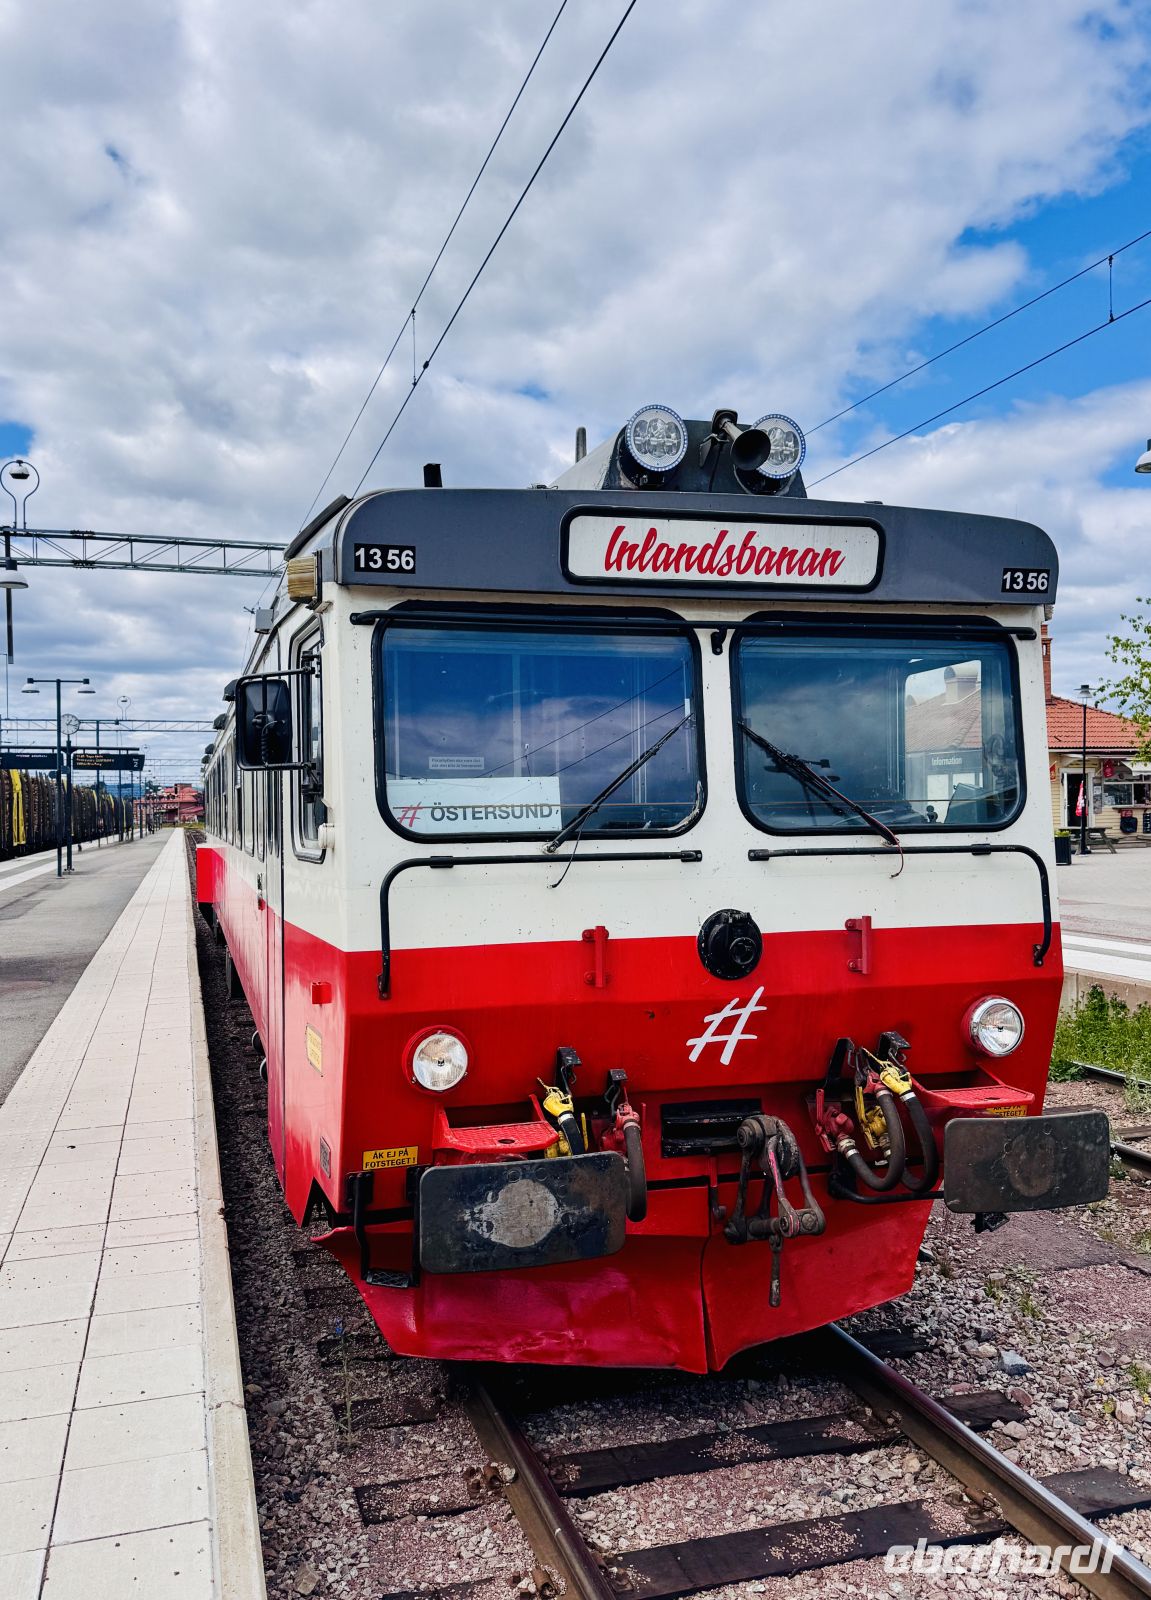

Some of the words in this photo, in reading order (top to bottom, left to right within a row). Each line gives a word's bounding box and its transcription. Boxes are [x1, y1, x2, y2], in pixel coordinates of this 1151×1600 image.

[604, 525, 846, 577] Inlandsbanan
[430, 801, 553, 822] ÖSTERSUND
[398, 1147, 409, 1157] PÅ
